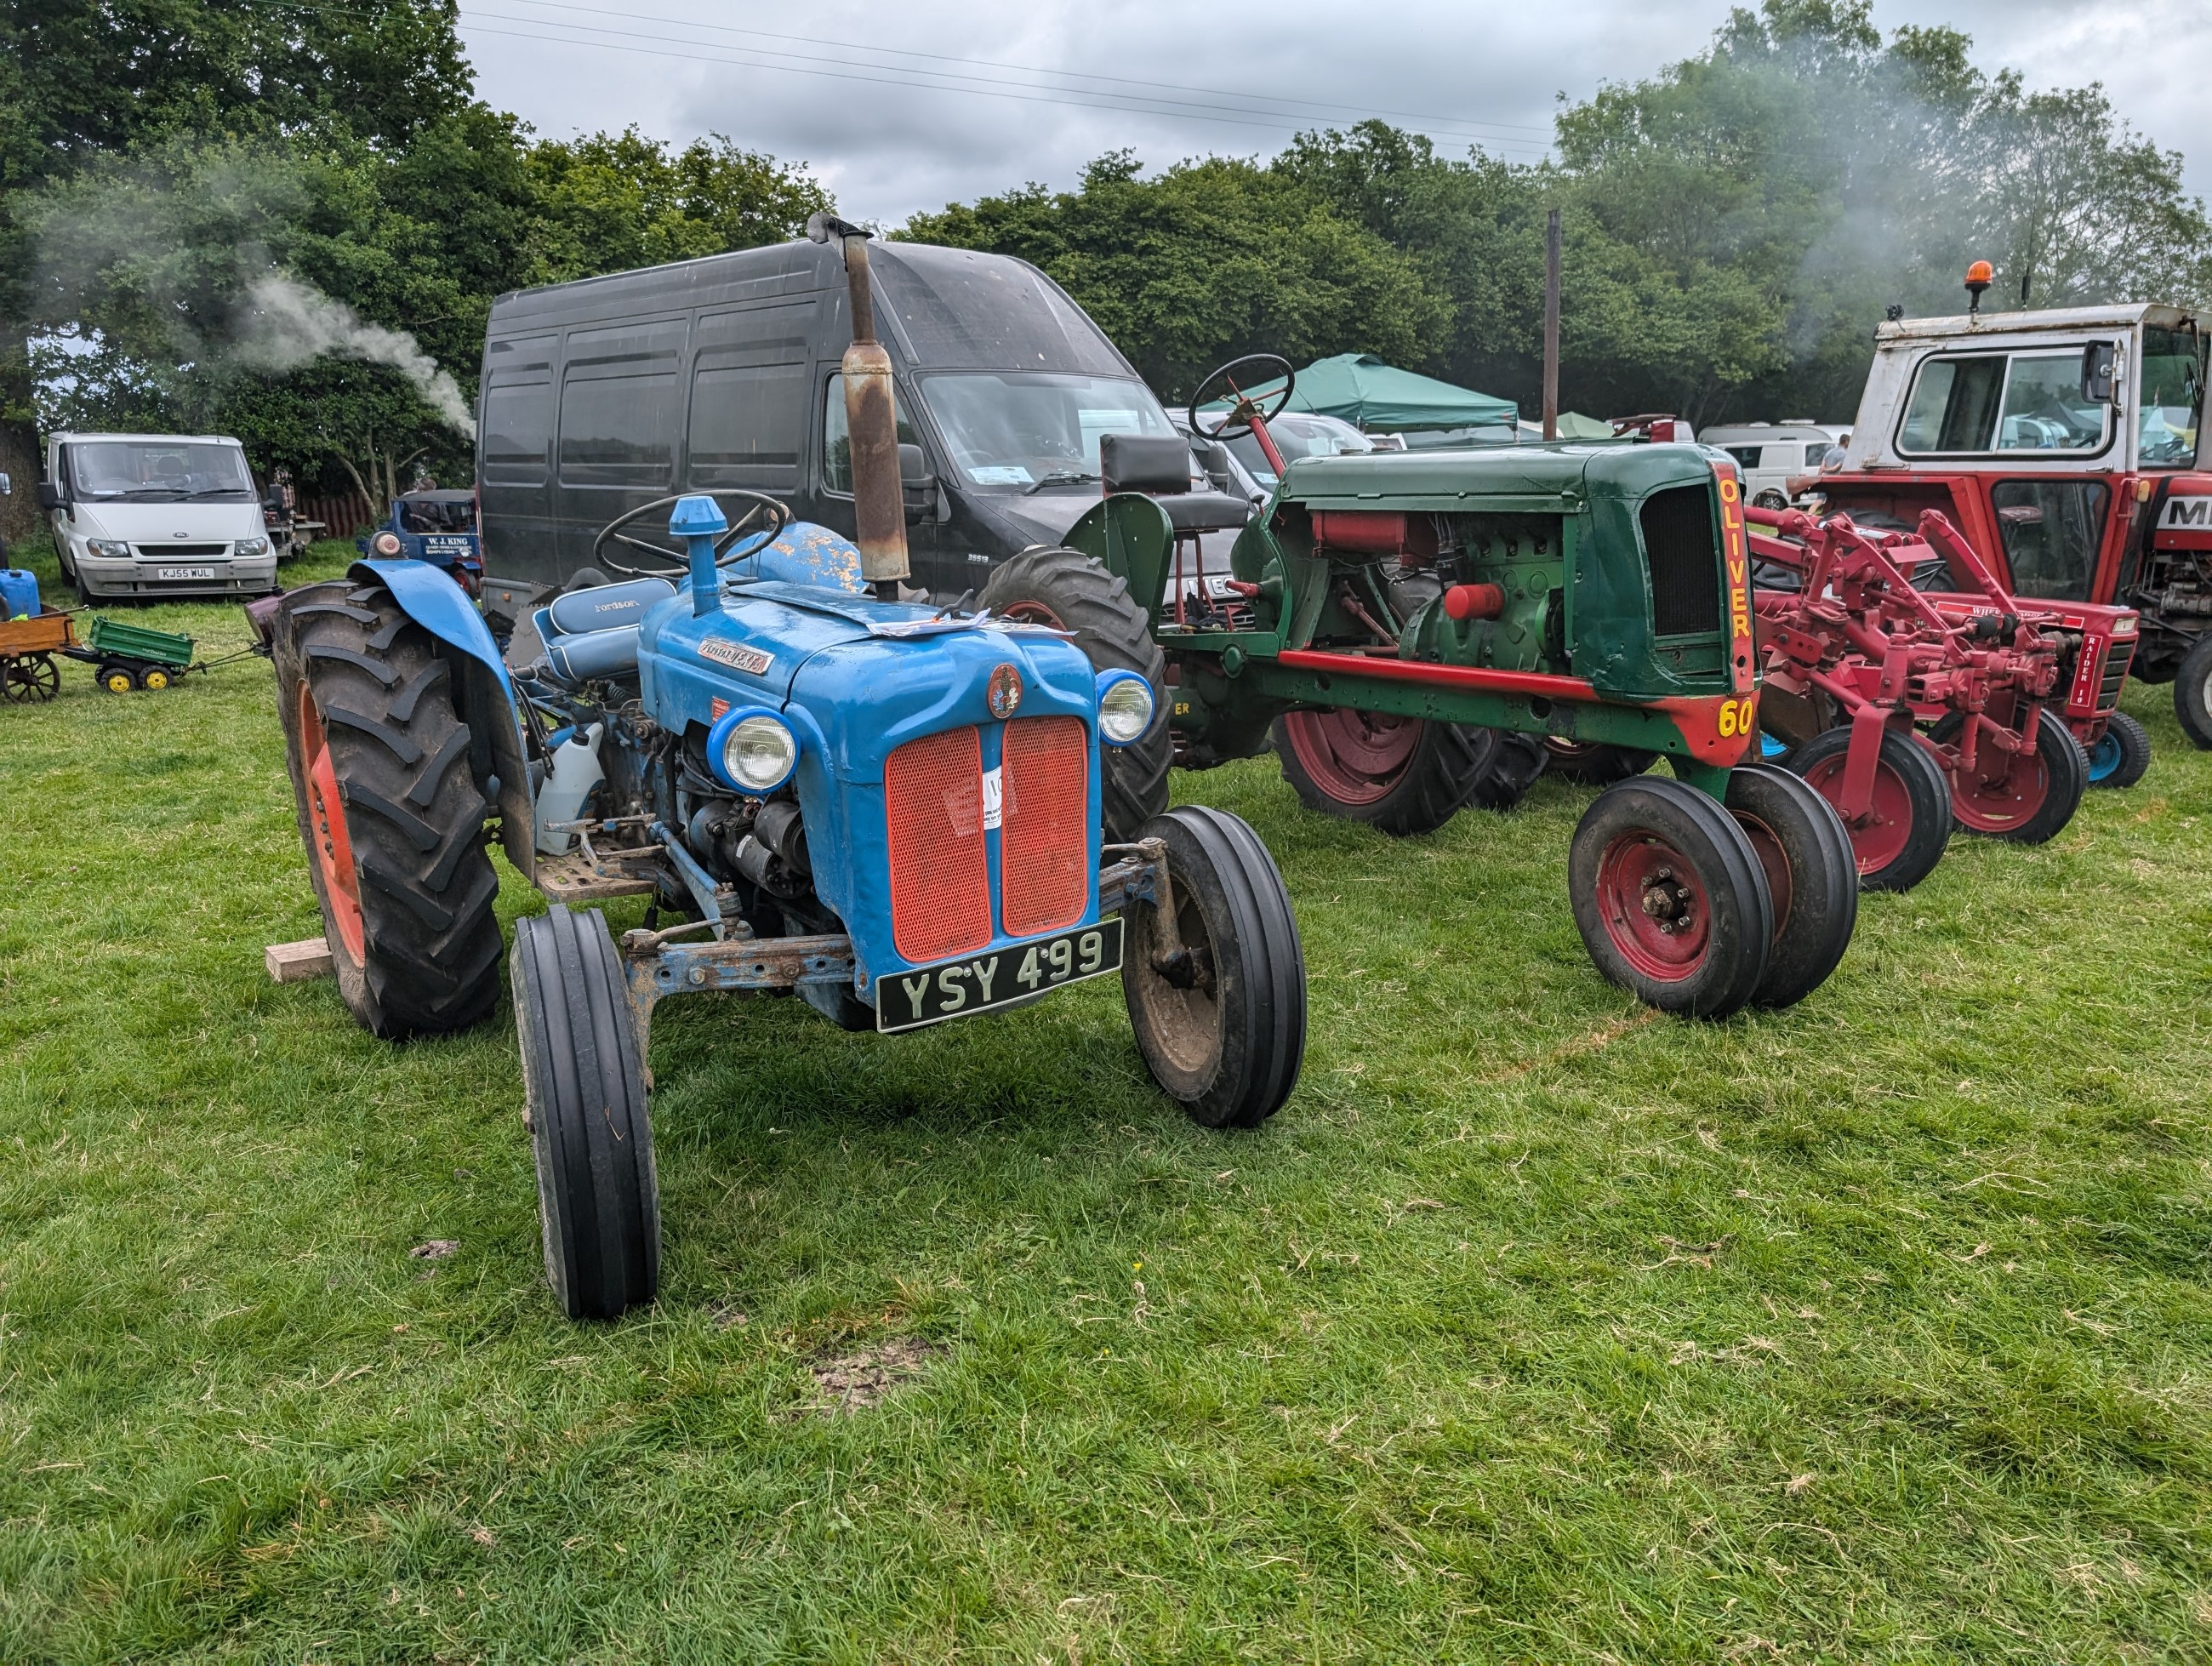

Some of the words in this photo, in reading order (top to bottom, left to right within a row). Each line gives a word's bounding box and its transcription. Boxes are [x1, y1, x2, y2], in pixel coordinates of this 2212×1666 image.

[2168, 500, 2212, 526] M
[162, 569, 189, 578] KJ55
[191, 568, 210, 578] WUL
[1719, 478, 1750, 638] OLIVER
[2080, 636, 2095, 682] RAIDER
[2077, 688, 2084, 704] 10
[1719, 699, 1753, 738] 60
[902, 956, 998, 1019] YSY
[1017, 931, 1103, 990] 499
